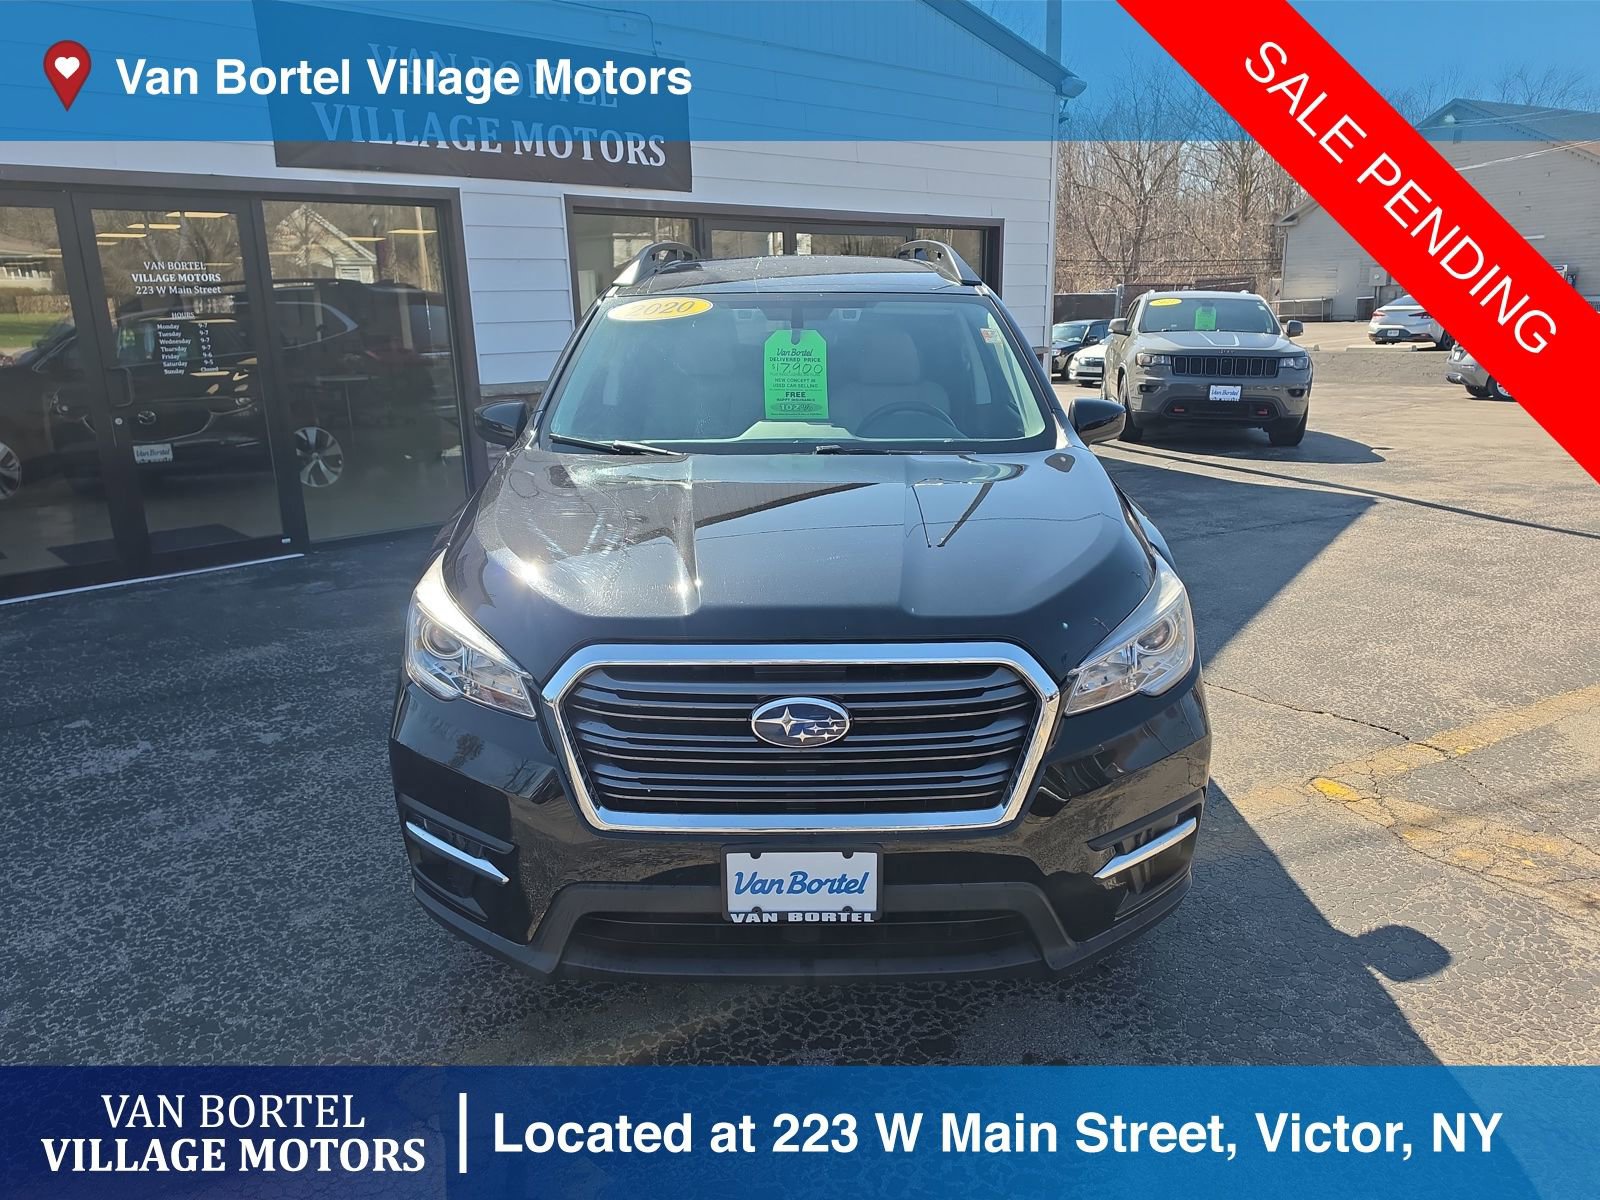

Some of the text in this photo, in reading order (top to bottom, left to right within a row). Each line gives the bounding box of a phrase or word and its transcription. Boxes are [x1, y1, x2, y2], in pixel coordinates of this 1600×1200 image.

[311, 102, 666, 167] VILLAGE MOTORS
[143, 262, 207, 271] VAN BORTEL
[131, 273, 221, 282] VILLAGE MOTORS
[136, 286, 222, 295] 223 W Main Street
[627, 300, 696, 316] 2020
[734, 870, 870, 895] Van Bortel
[730, 912, 875, 923] VAN BORTEL
